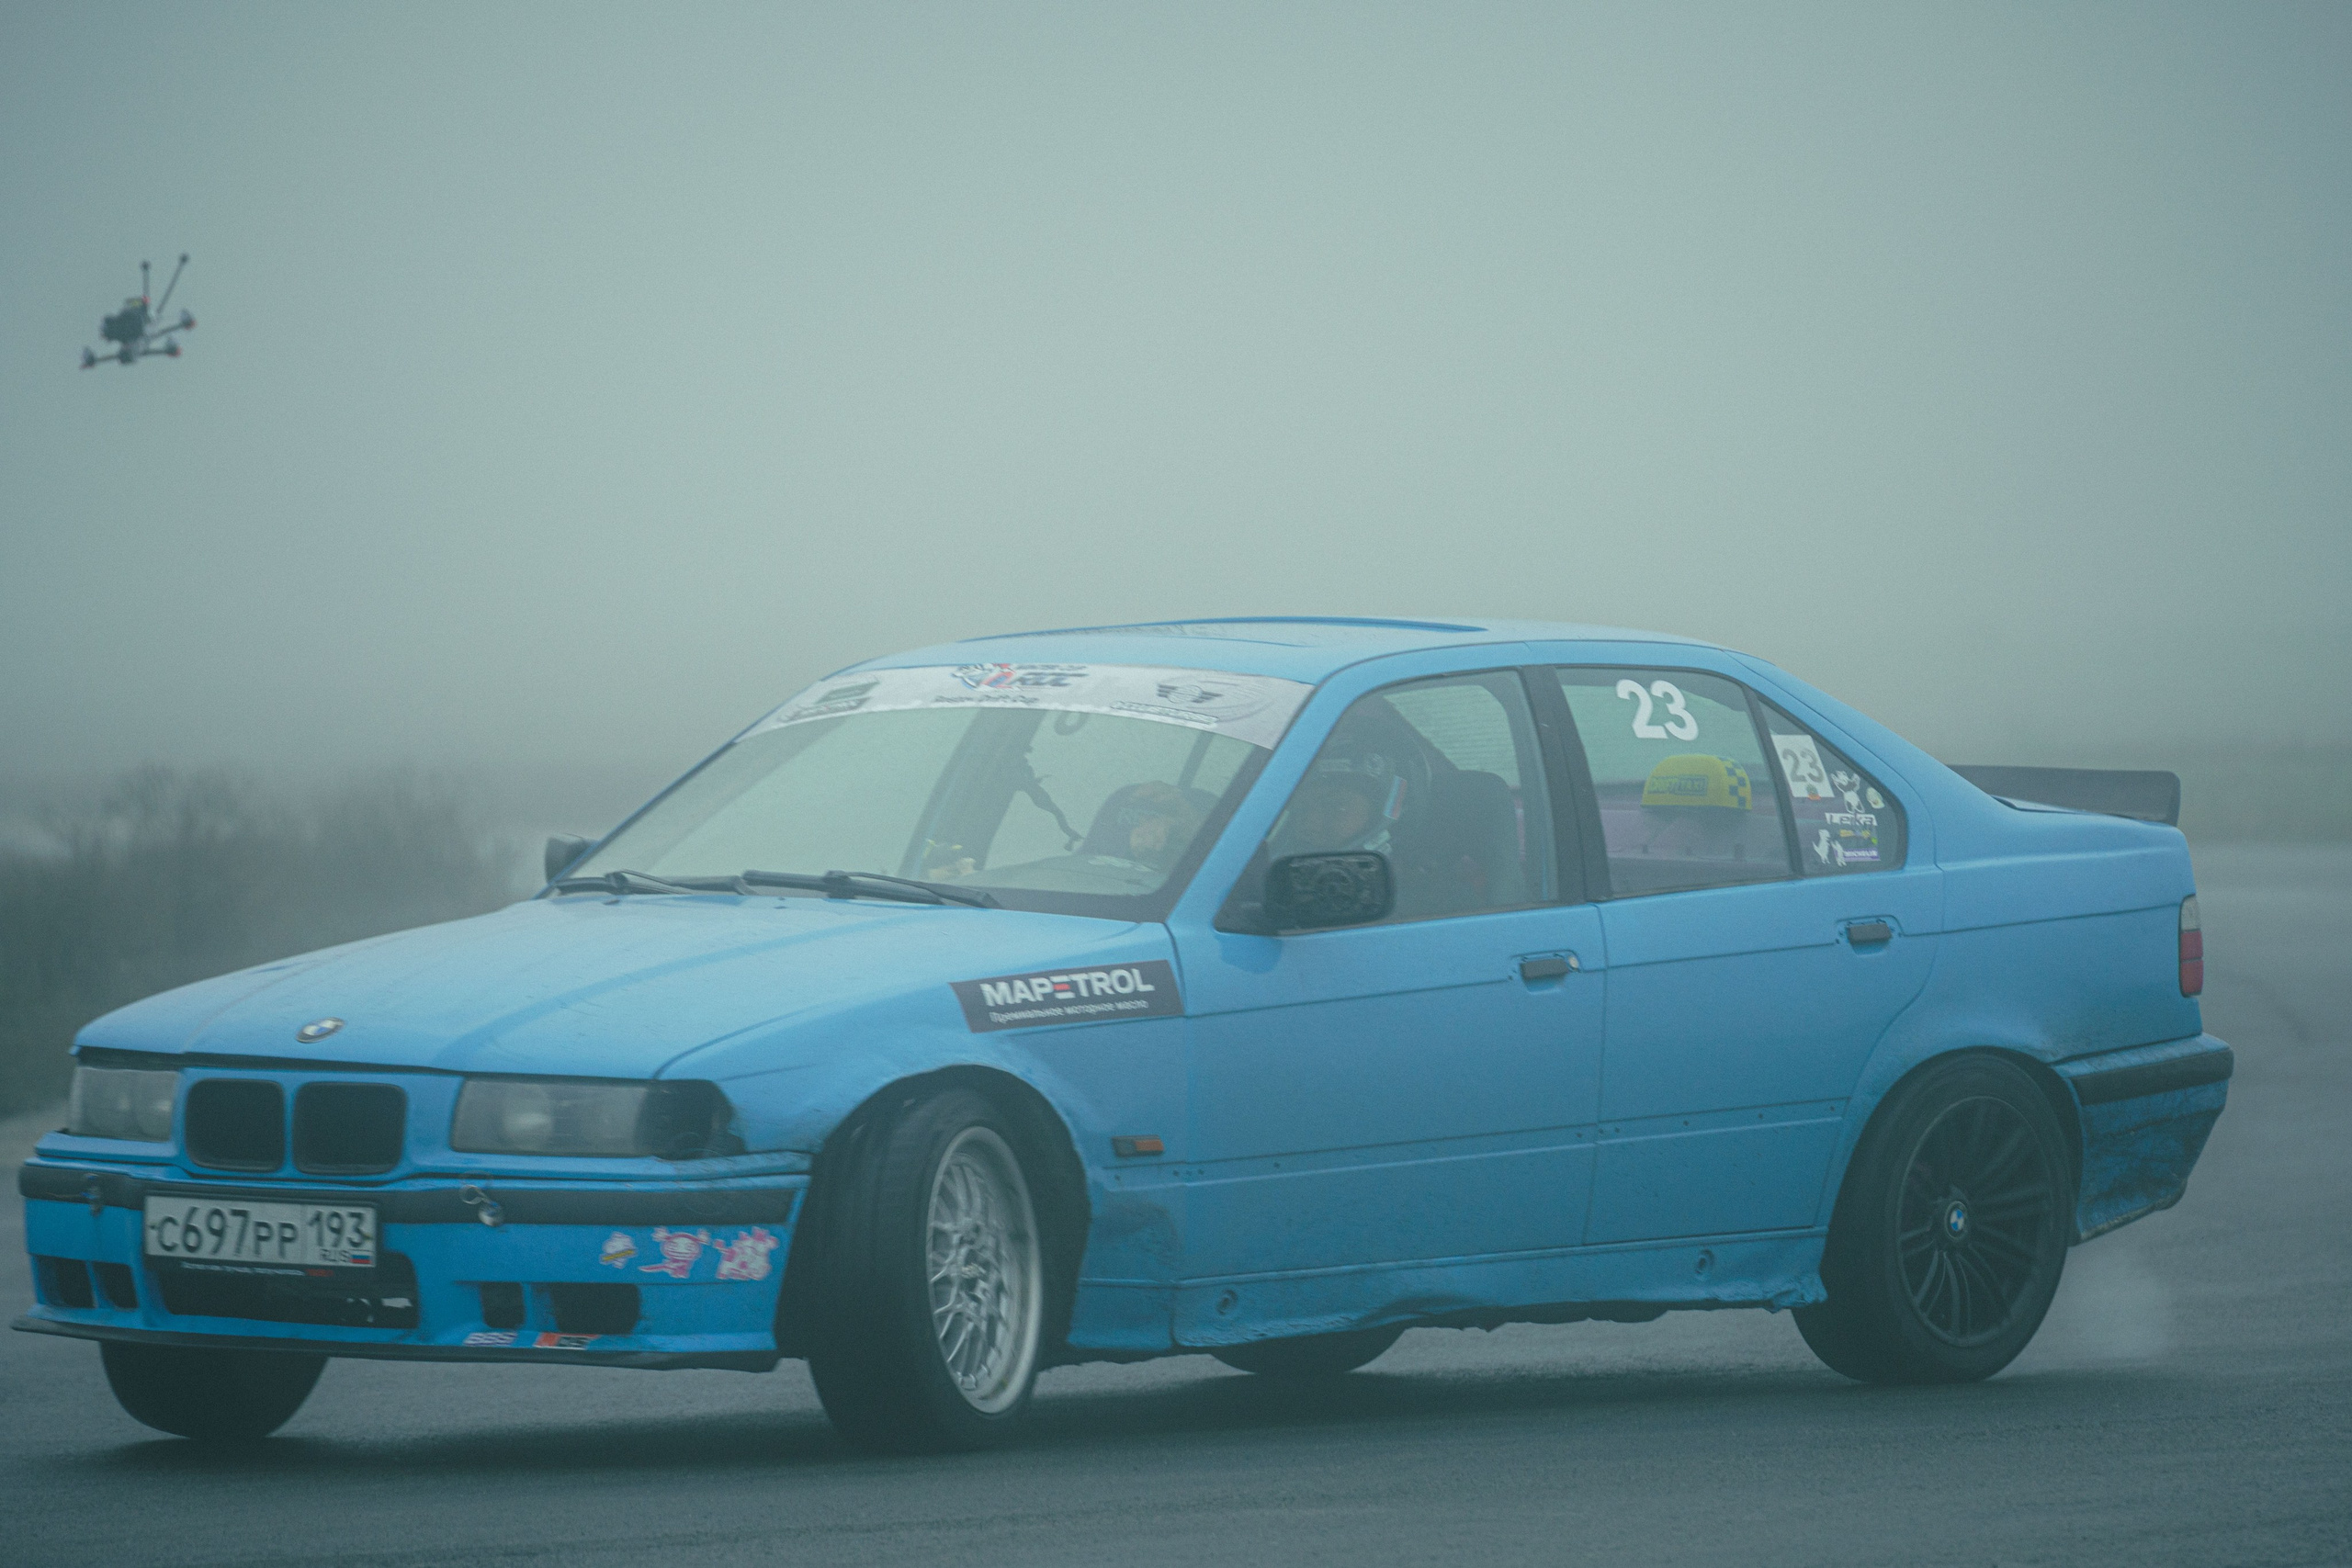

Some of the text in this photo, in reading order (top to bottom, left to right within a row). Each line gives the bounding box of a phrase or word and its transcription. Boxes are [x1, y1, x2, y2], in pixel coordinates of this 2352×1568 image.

[1616, 678, 1699, 741] 23
[1782, 748, 1826, 784] 23
[979, 968, 1156, 1008] MAPETROL
[319, 1248, 350, 1264] RUS
